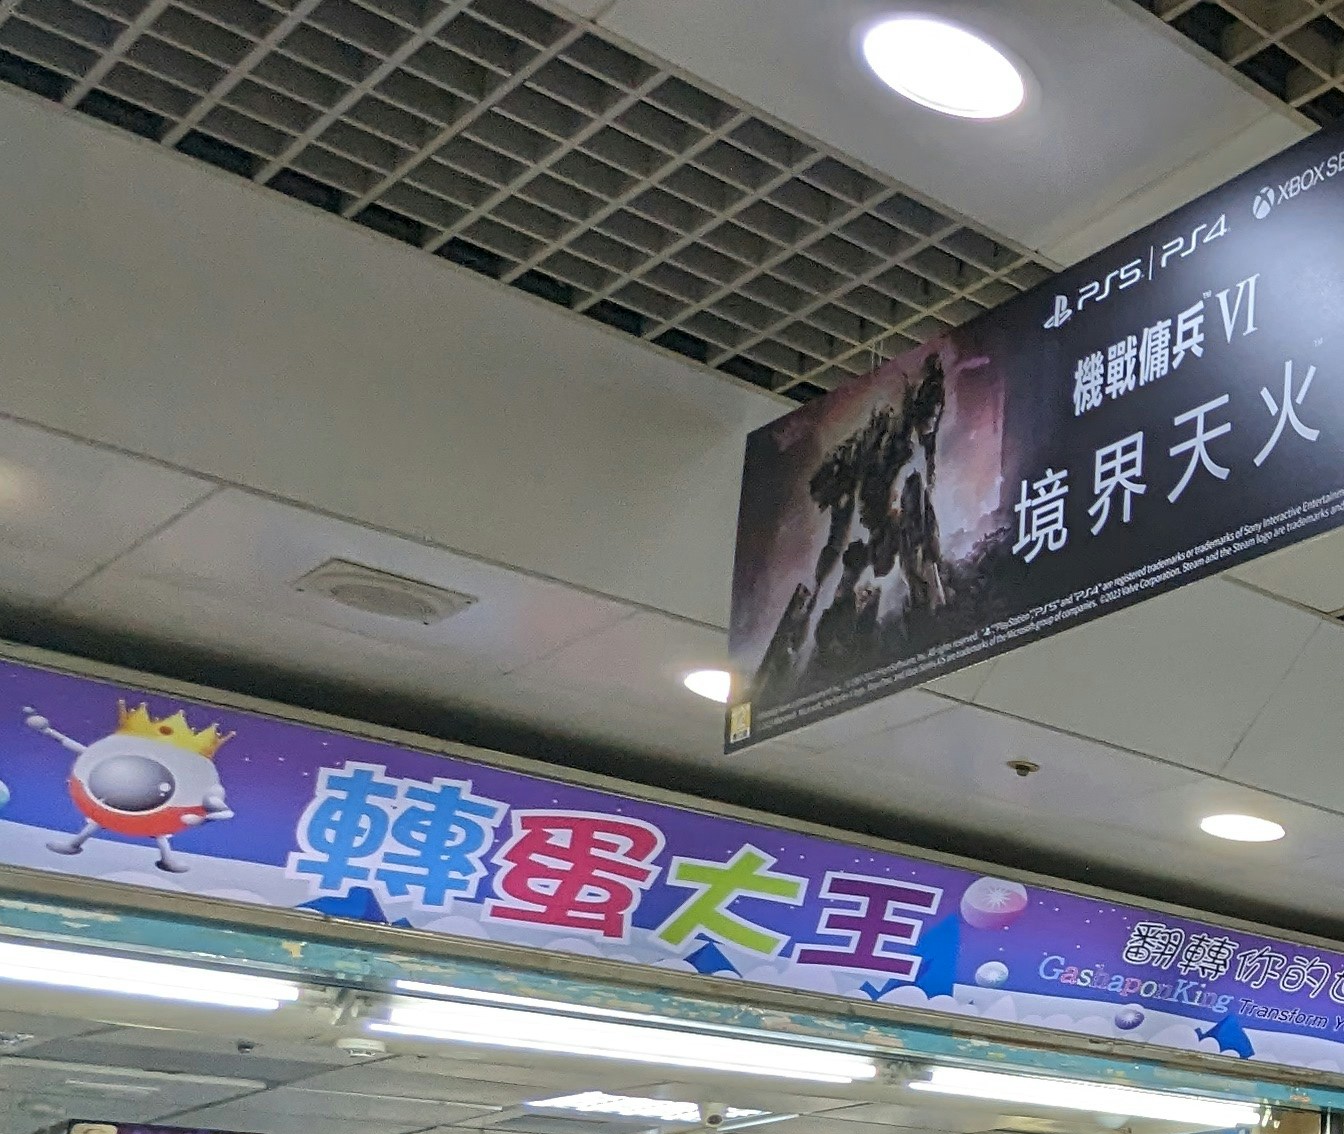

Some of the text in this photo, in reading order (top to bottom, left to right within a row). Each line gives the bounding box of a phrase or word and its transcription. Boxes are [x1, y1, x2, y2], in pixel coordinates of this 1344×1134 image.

[1277, 163, 1325, 205] XBOX
[1012, 360, 1320, 564] 境界天火
[1261, 503, 1303, 527] Interactive
[1285, 508, 1331, 535] trademarks
[286, 760, 943, 982] 轉蛋大王
[1239, 998, 1328, 1030] Transform
